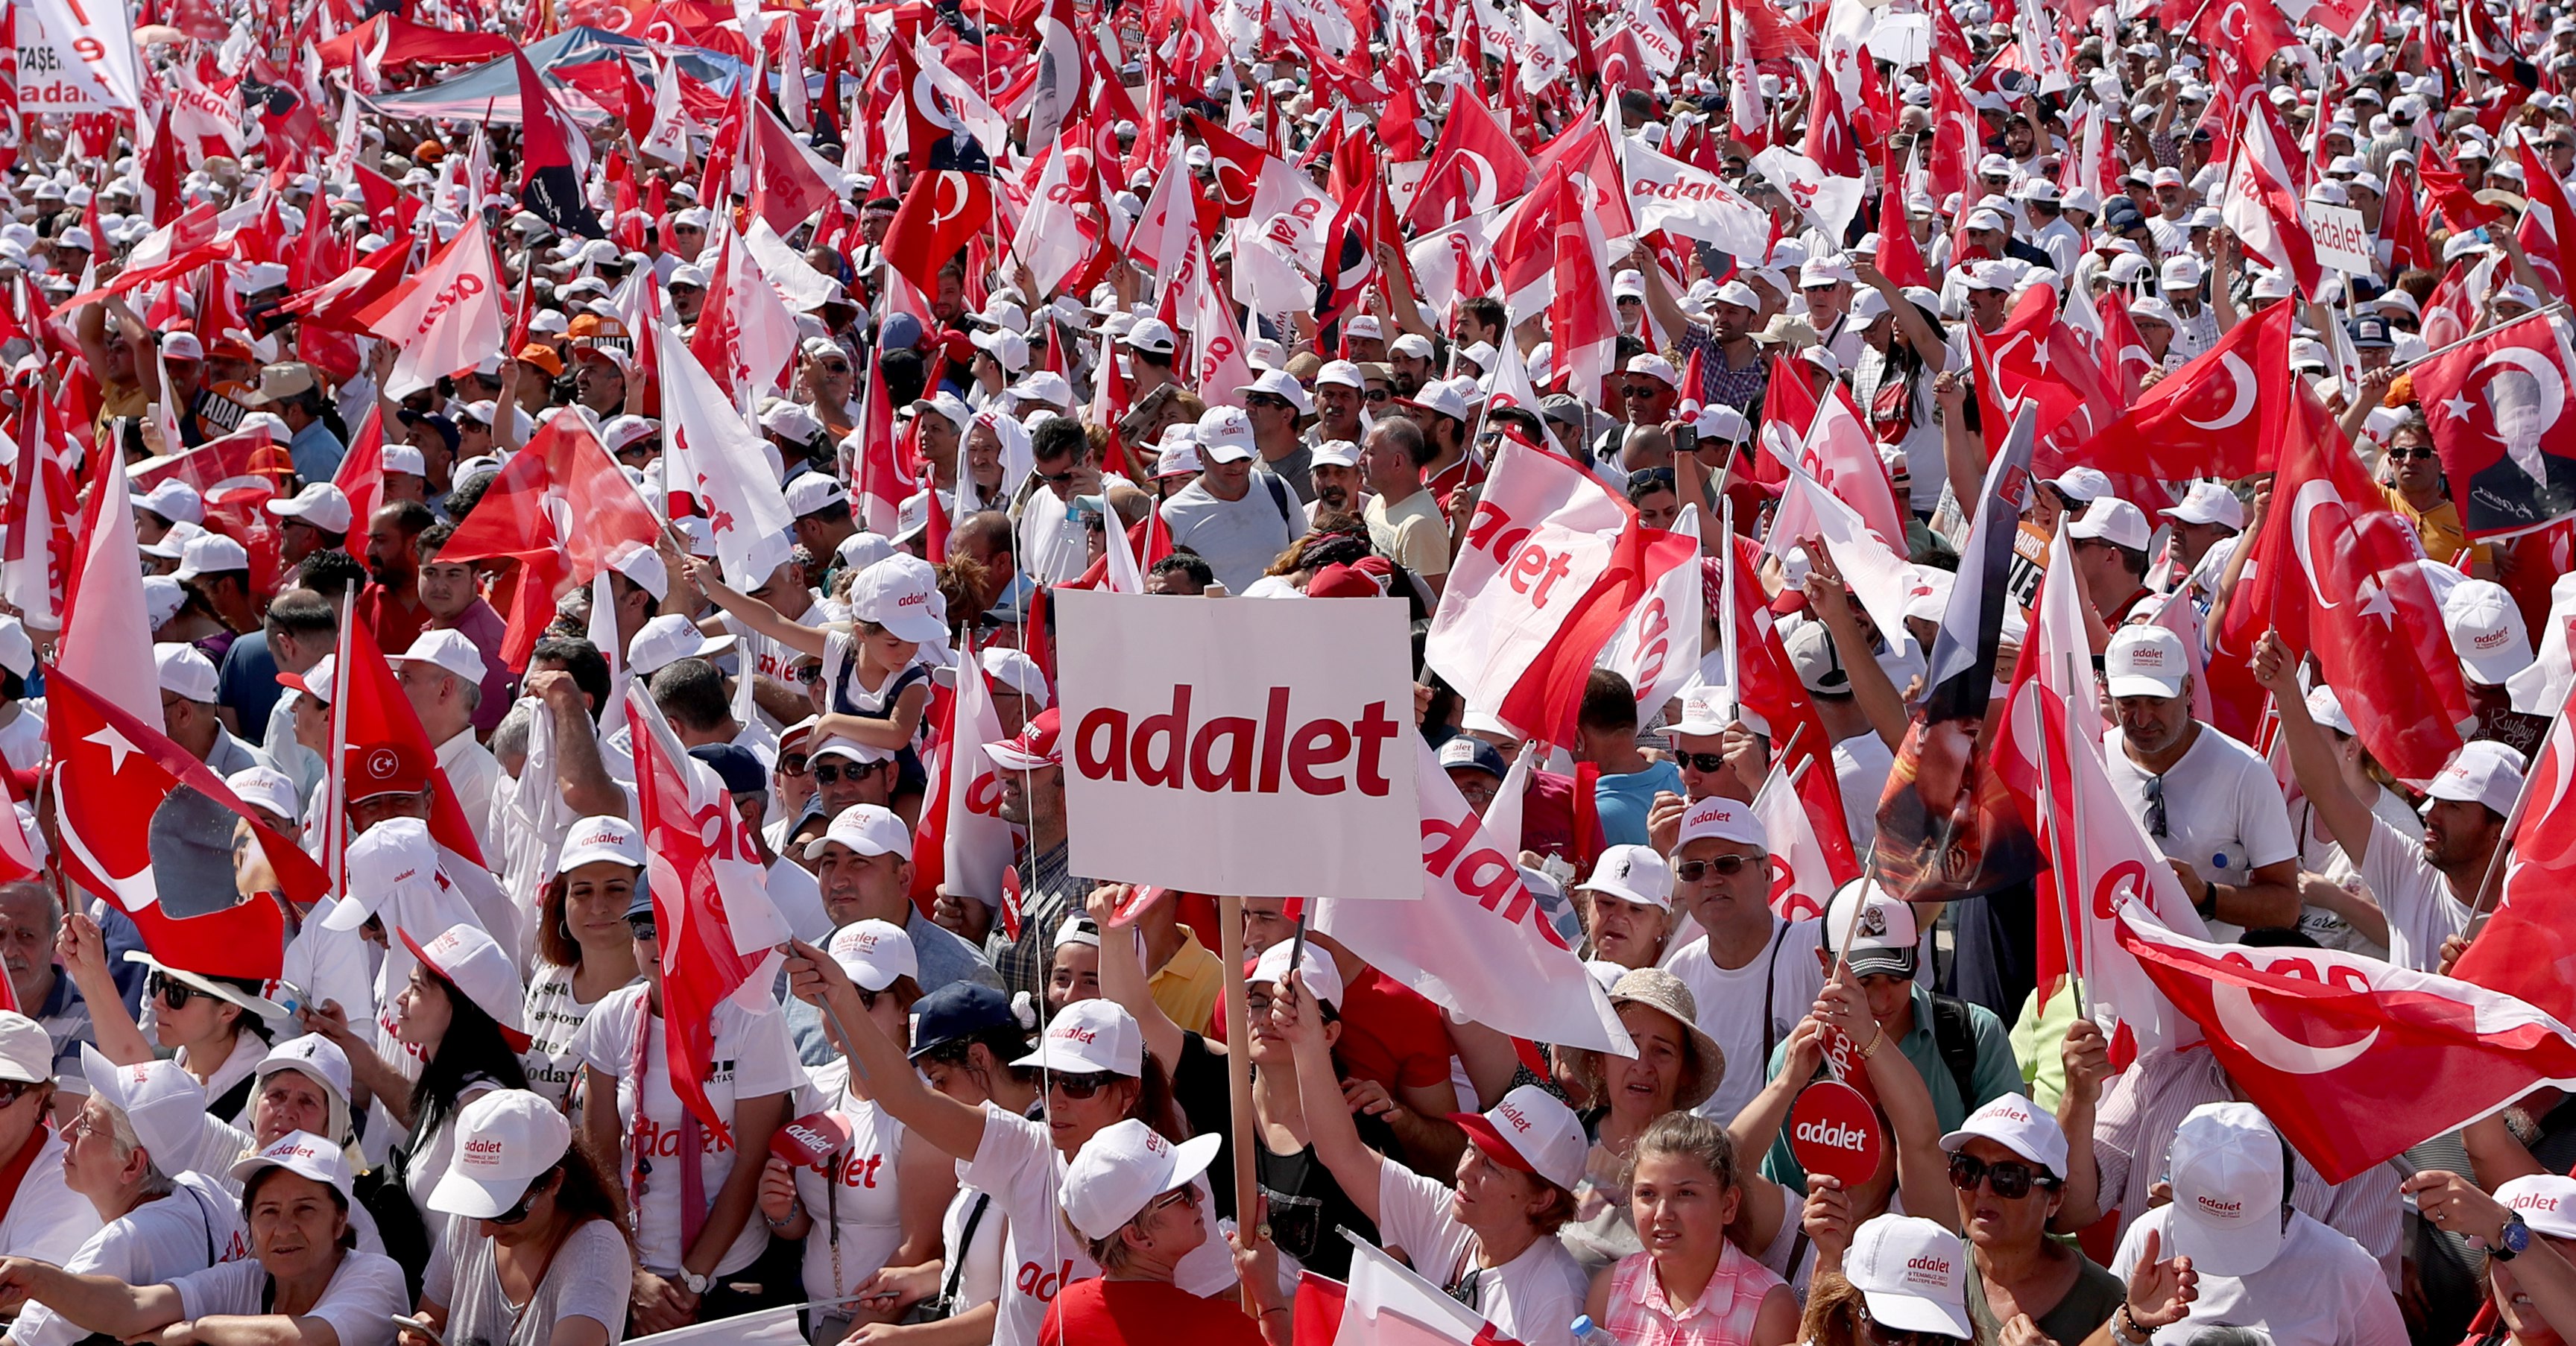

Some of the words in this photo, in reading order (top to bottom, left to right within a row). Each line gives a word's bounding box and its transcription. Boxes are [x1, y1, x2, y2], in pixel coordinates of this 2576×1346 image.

[1479, 25, 1520, 53] dale
[1626, 10, 1677, 63] adalet
[17, 45, 66, 75] TAŞE
[19, 80, 95, 102] ada
[1632, 176, 1749, 211] adale
[2313, 217, 2366, 256] adalet
[1354, 321, 1377, 332] adalet
[1538, 358, 1552, 370] ada
[1460, 387, 1476, 399] alet
[201, 391, 244, 432] ADAL
[2474, 625, 2508, 643] adalet
[2133, 648, 2163, 659] adalet
[1073, 683, 1398, 797] adalet
[235, 778, 275, 789] adalet
[1690, 809, 1731, 827] adalet
[581, 832, 625, 847] adalet
[394, 868, 416, 882] adalet
[1421, 811, 1571, 952] dal
[1003, 888, 1020, 925] adalet
[836, 932, 880, 947] adalet
[1266, 950, 1307, 964] adalt
[1050, 1026, 1096, 1045] adalet
[1831, 1031, 1854, 1083] ada
[1497, 1101, 1532, 1134] adalet
[1976, 1106, 2029, 1123] adalet
[642, 1120, 730, 1157] daet
[785, 1124, 835, 1154] adalet
[1146, 1128, 1159, 1152] ada
[1796, 1118, 1866, 1152] adalet
[265, 1143, 315, 1159] adalet
[464, 1140, 502, 1153] adalet
[2197, 1195, 2242, 1211] adalet
[2501, 1192, 2559, 1213] adalet
[1907, 1255, 1950, 1274] adalet
[1907, 1277, 1931, 1285] MALTEPE
[1913, 1271, 1936, 1280] TEMMUZ
